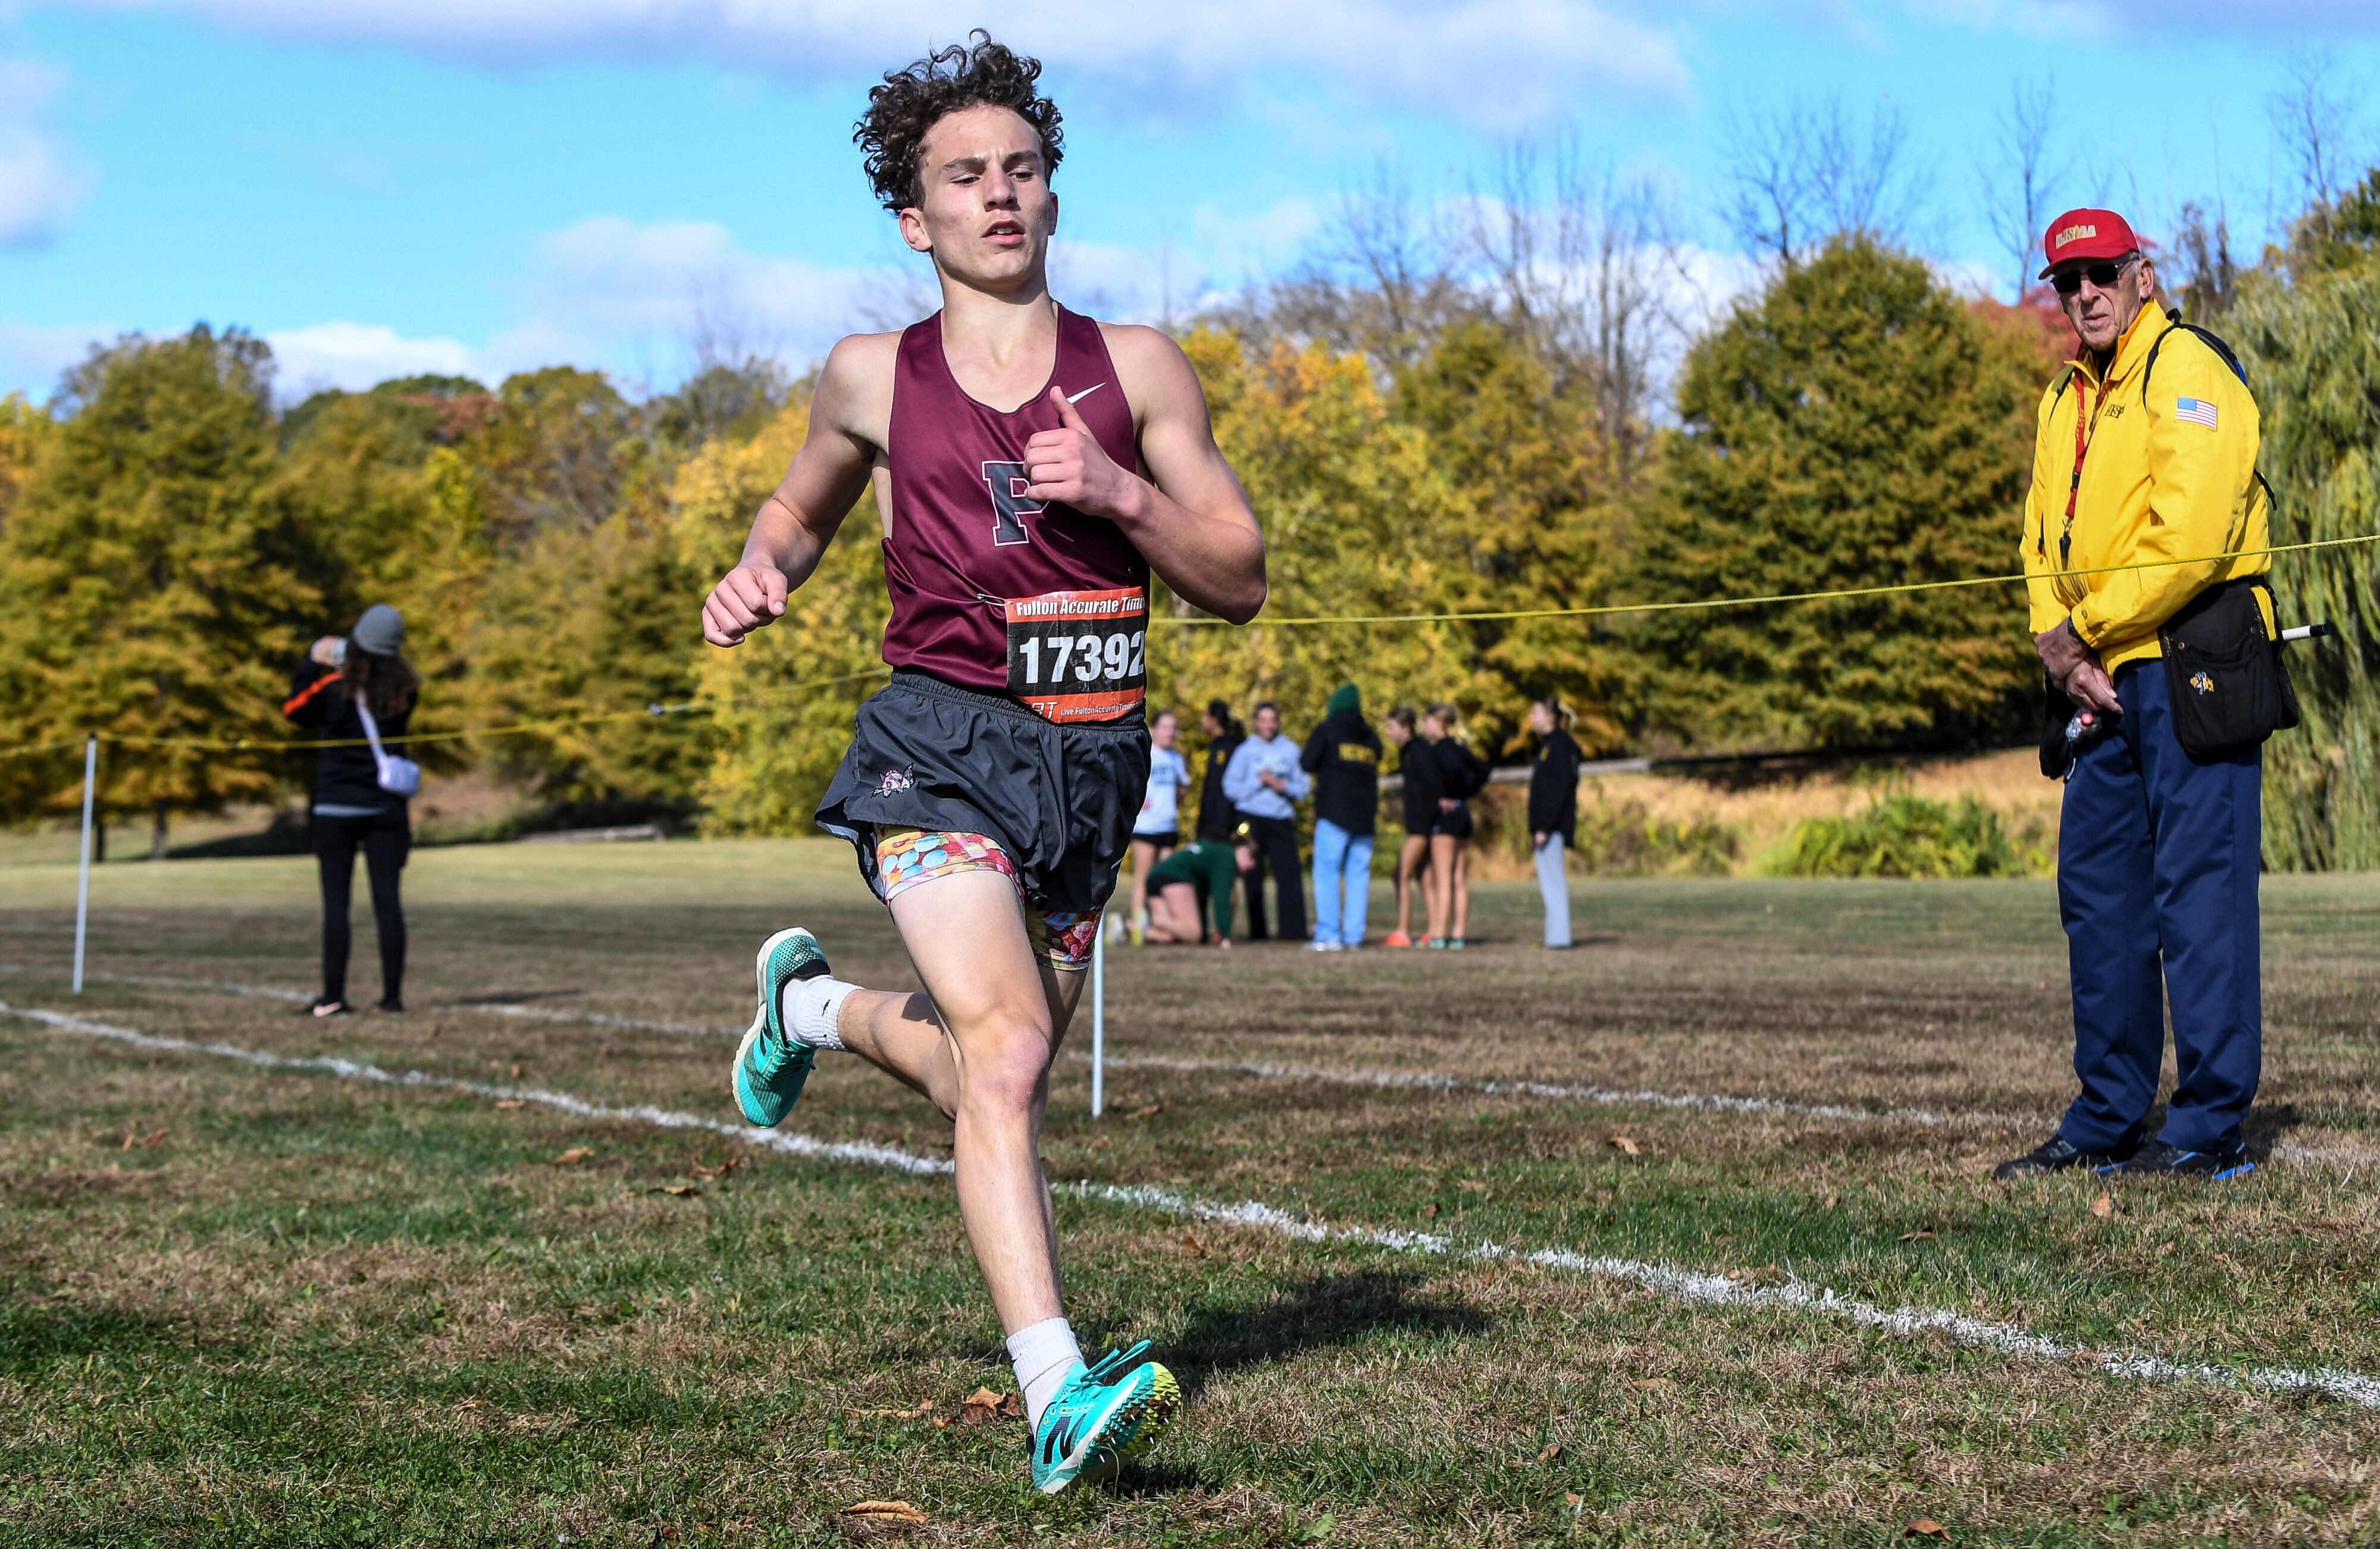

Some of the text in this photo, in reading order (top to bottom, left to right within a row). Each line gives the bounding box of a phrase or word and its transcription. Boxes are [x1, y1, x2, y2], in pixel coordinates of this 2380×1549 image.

[982, 460, 1050, 546] P
[1016, 600, 1058, 616] Fulton
[1060, 599, 1119, 614] Accurate
[1020, 630, 1144, 683] 17392
